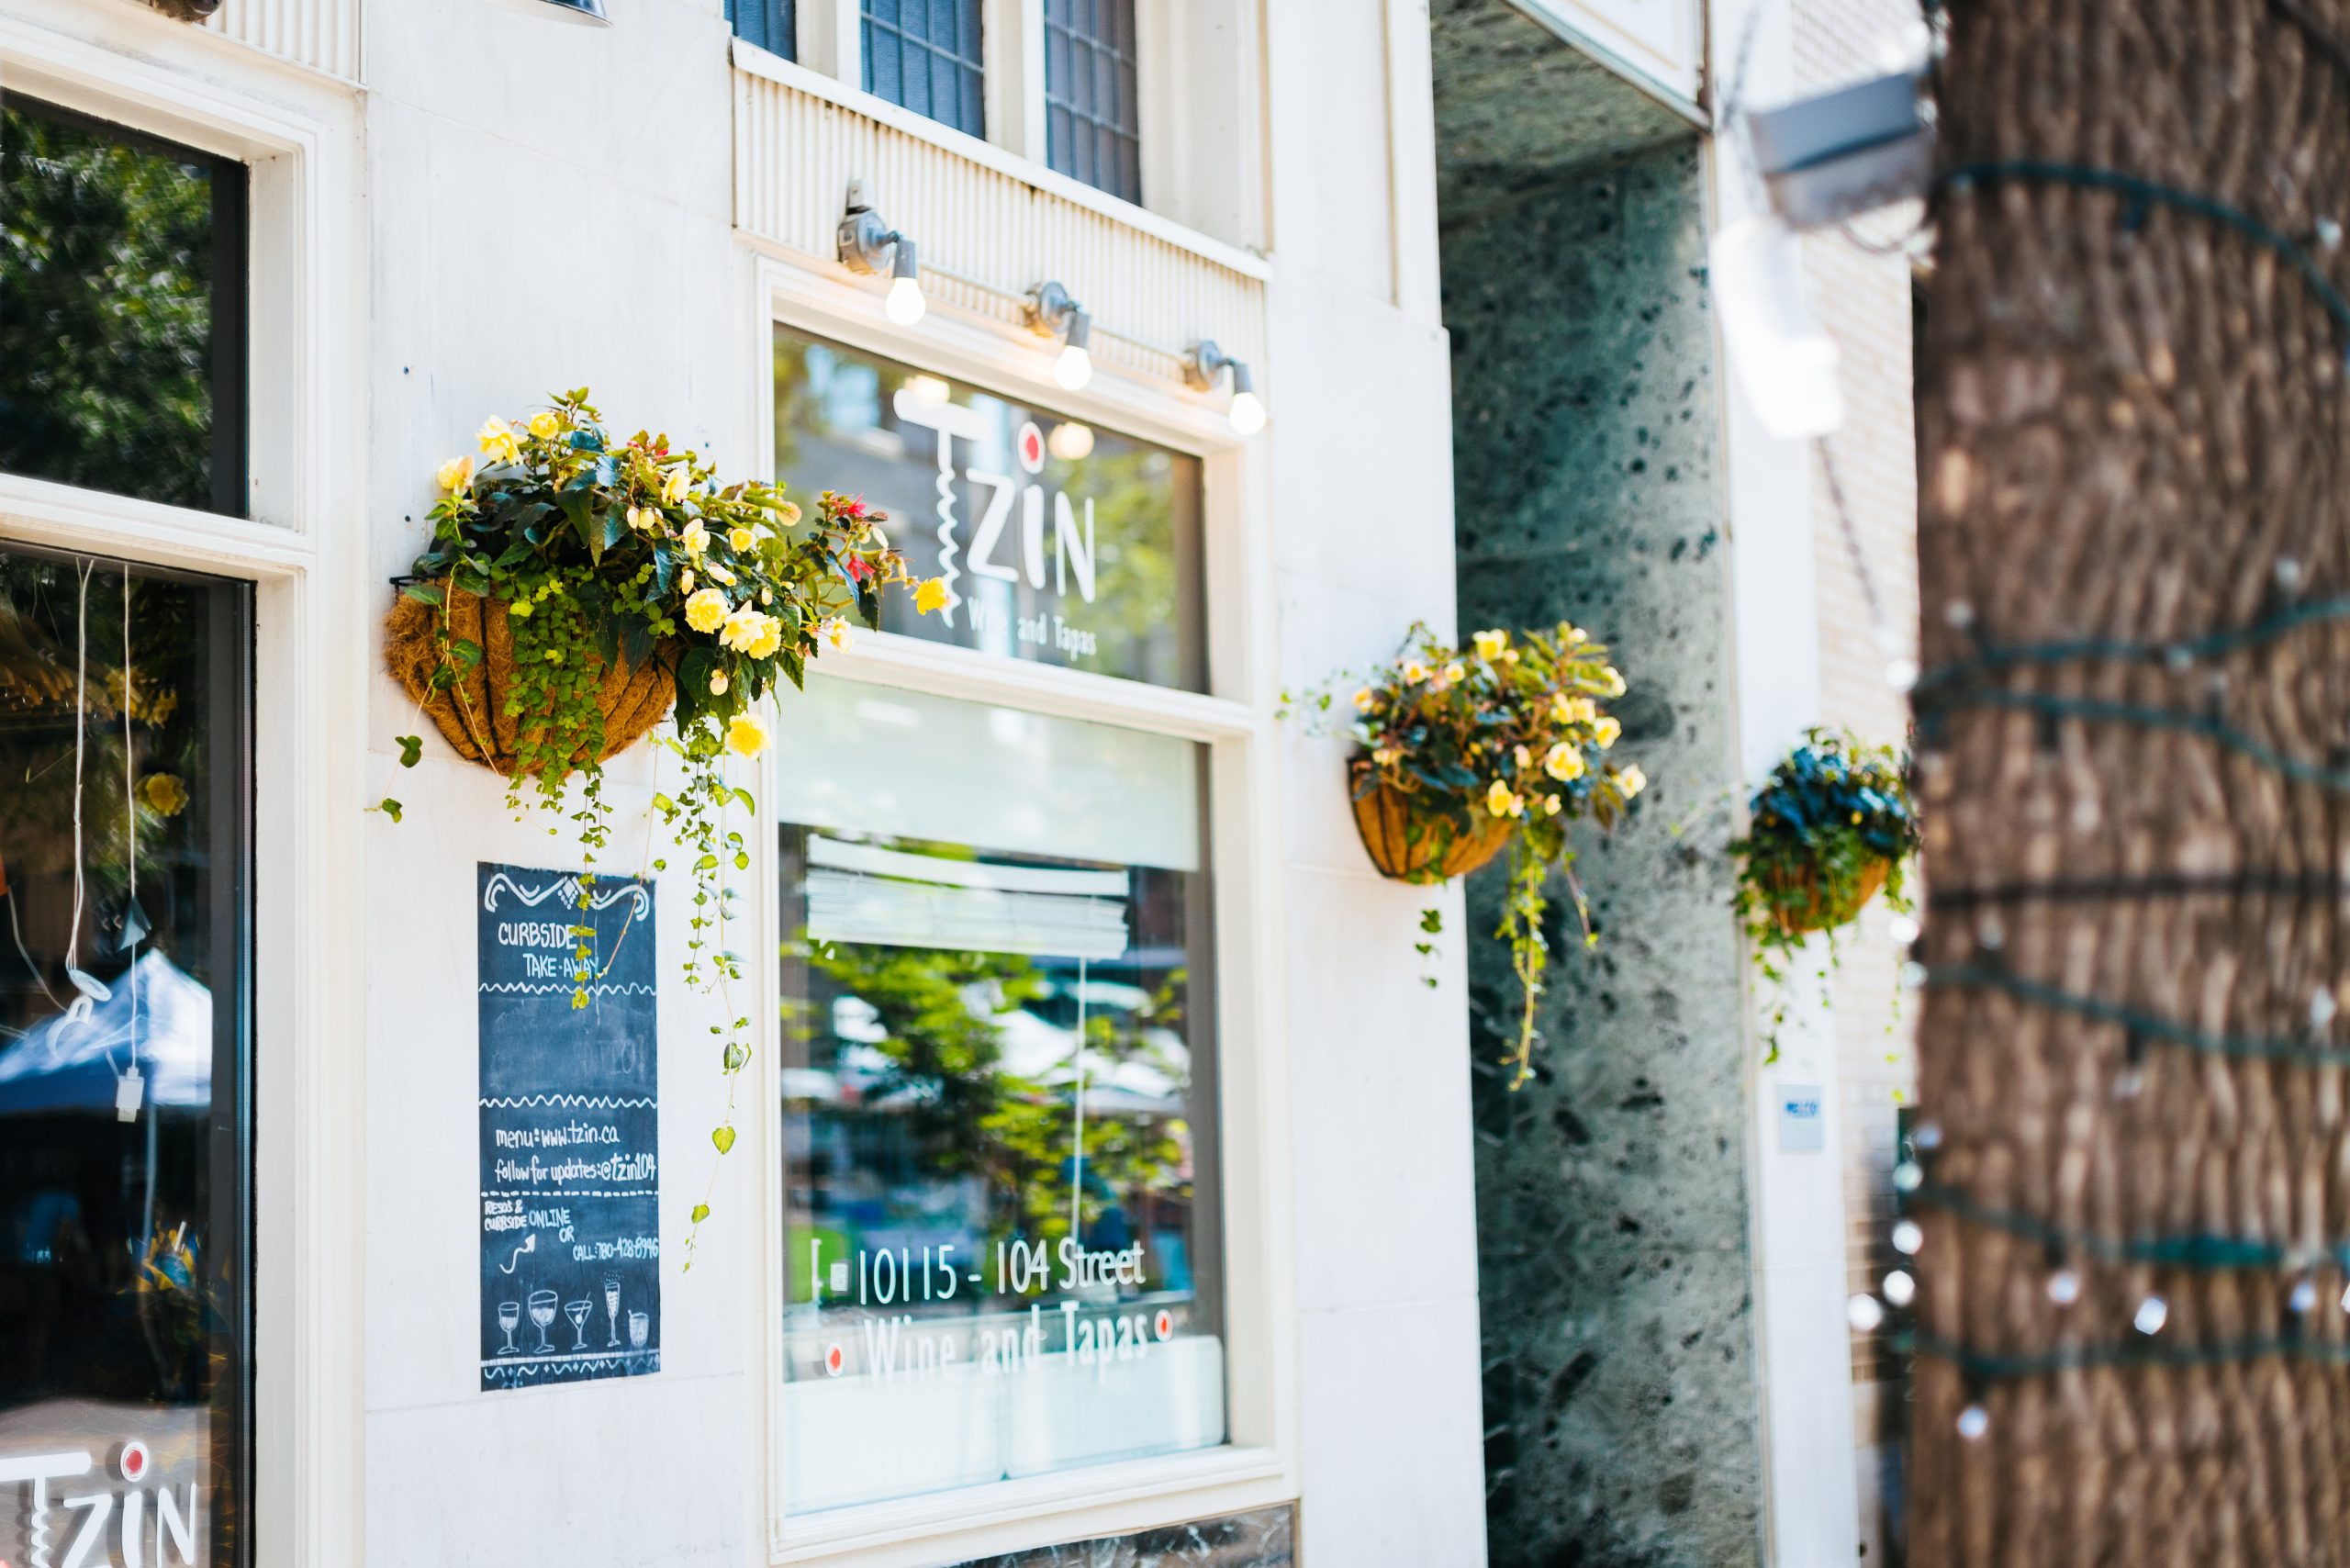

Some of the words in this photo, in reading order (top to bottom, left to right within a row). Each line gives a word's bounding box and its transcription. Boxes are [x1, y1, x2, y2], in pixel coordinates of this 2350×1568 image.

[1017, 611, 1047, 645] and
[1053, 614, 1097, 661] Tapas
[498, 922, 577, 950] CURBSIDE
[494, 1158, 530, 1183] follow
[530, 1154, 549, 1185] for
[484, 1215, 528, 1232] CURBSIDE
[528, 1206, 572, 1229] ONLINE
[514, 1199, 524, 1215] &
[558, 1225, 576, 1243] OR
[858, 1243, 957, 1305] 10115
[997, 1238, 1051, 1294] 104
[1058, 1236, 1147, 1290] Street
[863, 1314, 957, 1387] Wine
[979, 1303, 1041, 1376] and
[1059, 1299, 1148, 1384] Tapas
